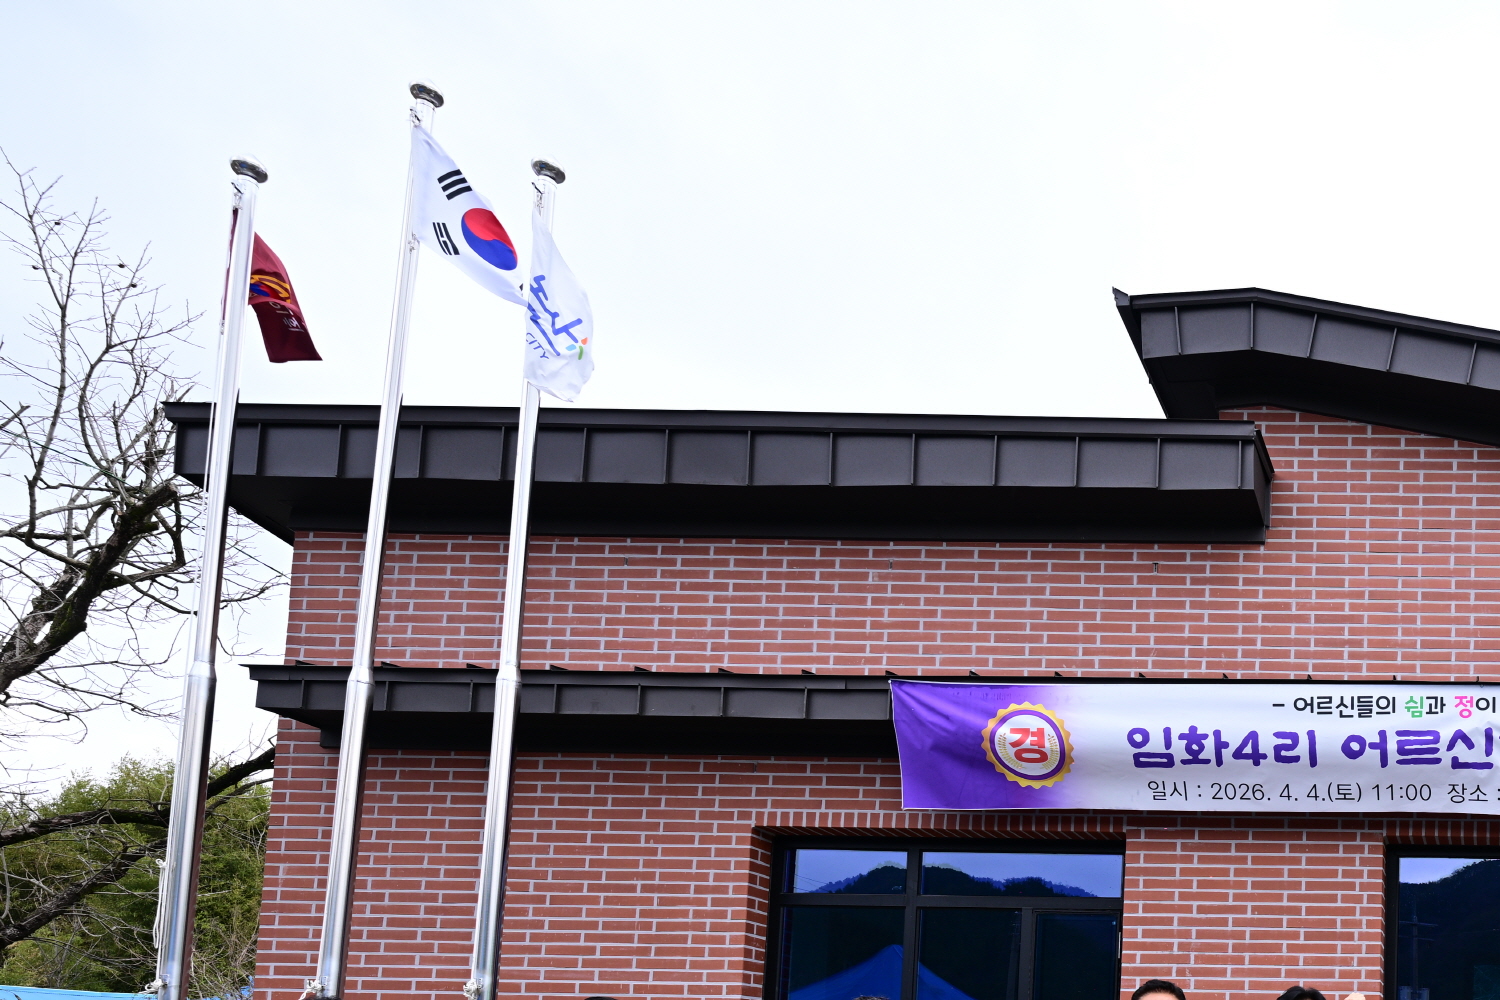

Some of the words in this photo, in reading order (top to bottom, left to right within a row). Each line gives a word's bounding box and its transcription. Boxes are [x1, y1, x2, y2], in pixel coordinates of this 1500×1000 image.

[1293, 695, 1397, 719] 어르신들의
[1404, 695, 1447, 719] 쉼과
[1454, 695, 1497, 719] 정이
[1009, 727, 1049, 764] 경
[1126, 725, 1318, 769] 임화4리
[1147, 780, 1189, 801] 일시
[1210, 782, 1271, 801] 2026.
[1371, 783, 1432, 802] 11:00
[1447, 783, 1489, 803] 장소
